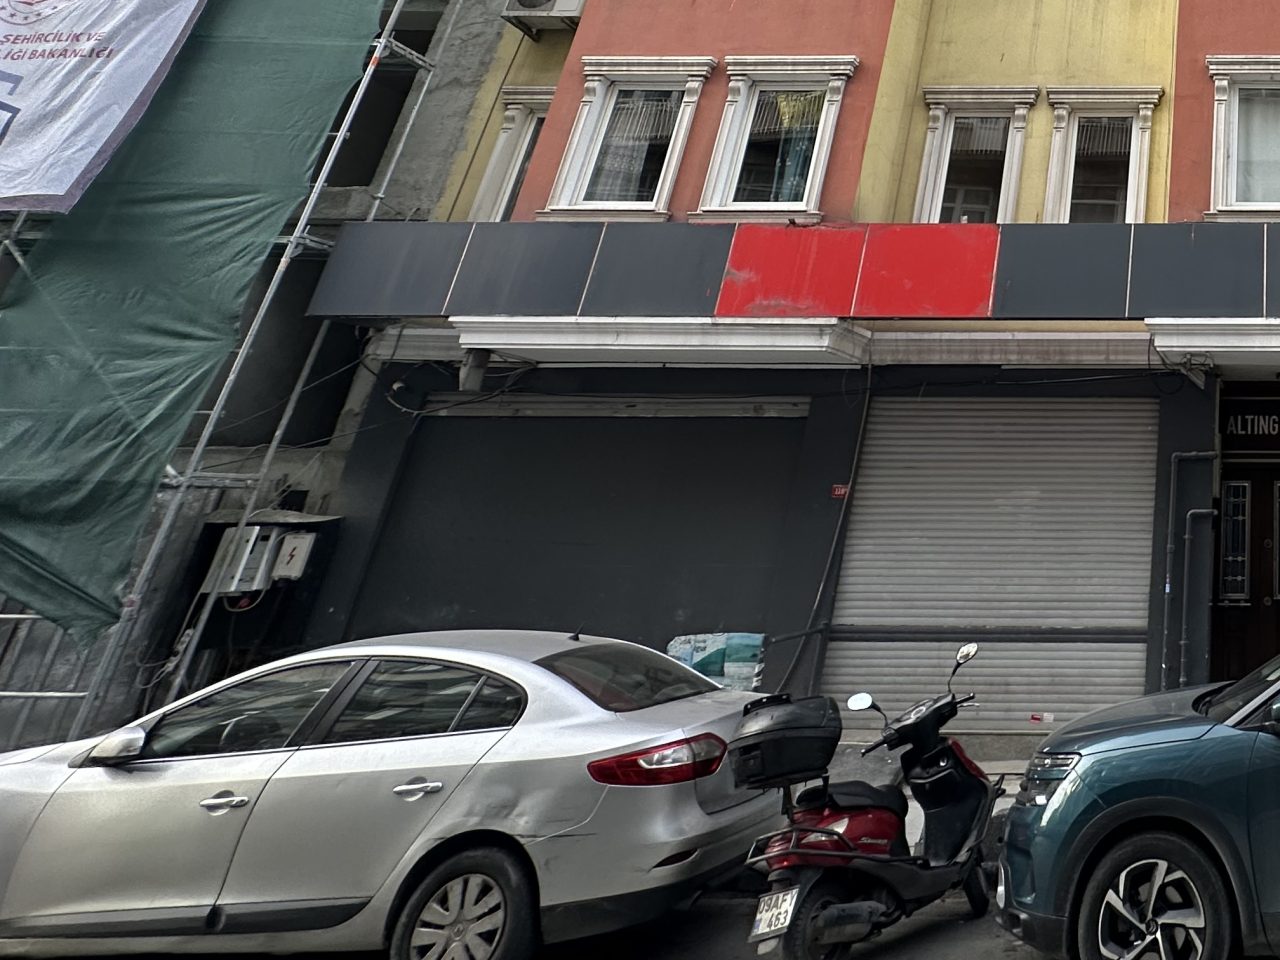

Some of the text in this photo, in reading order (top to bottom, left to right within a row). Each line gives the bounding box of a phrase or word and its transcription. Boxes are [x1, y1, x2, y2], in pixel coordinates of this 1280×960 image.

[86, 31, 107, 42] VE
[27, 46, 115, 59] BAKANLIĞI
[767, 909, 789, 930] 463
